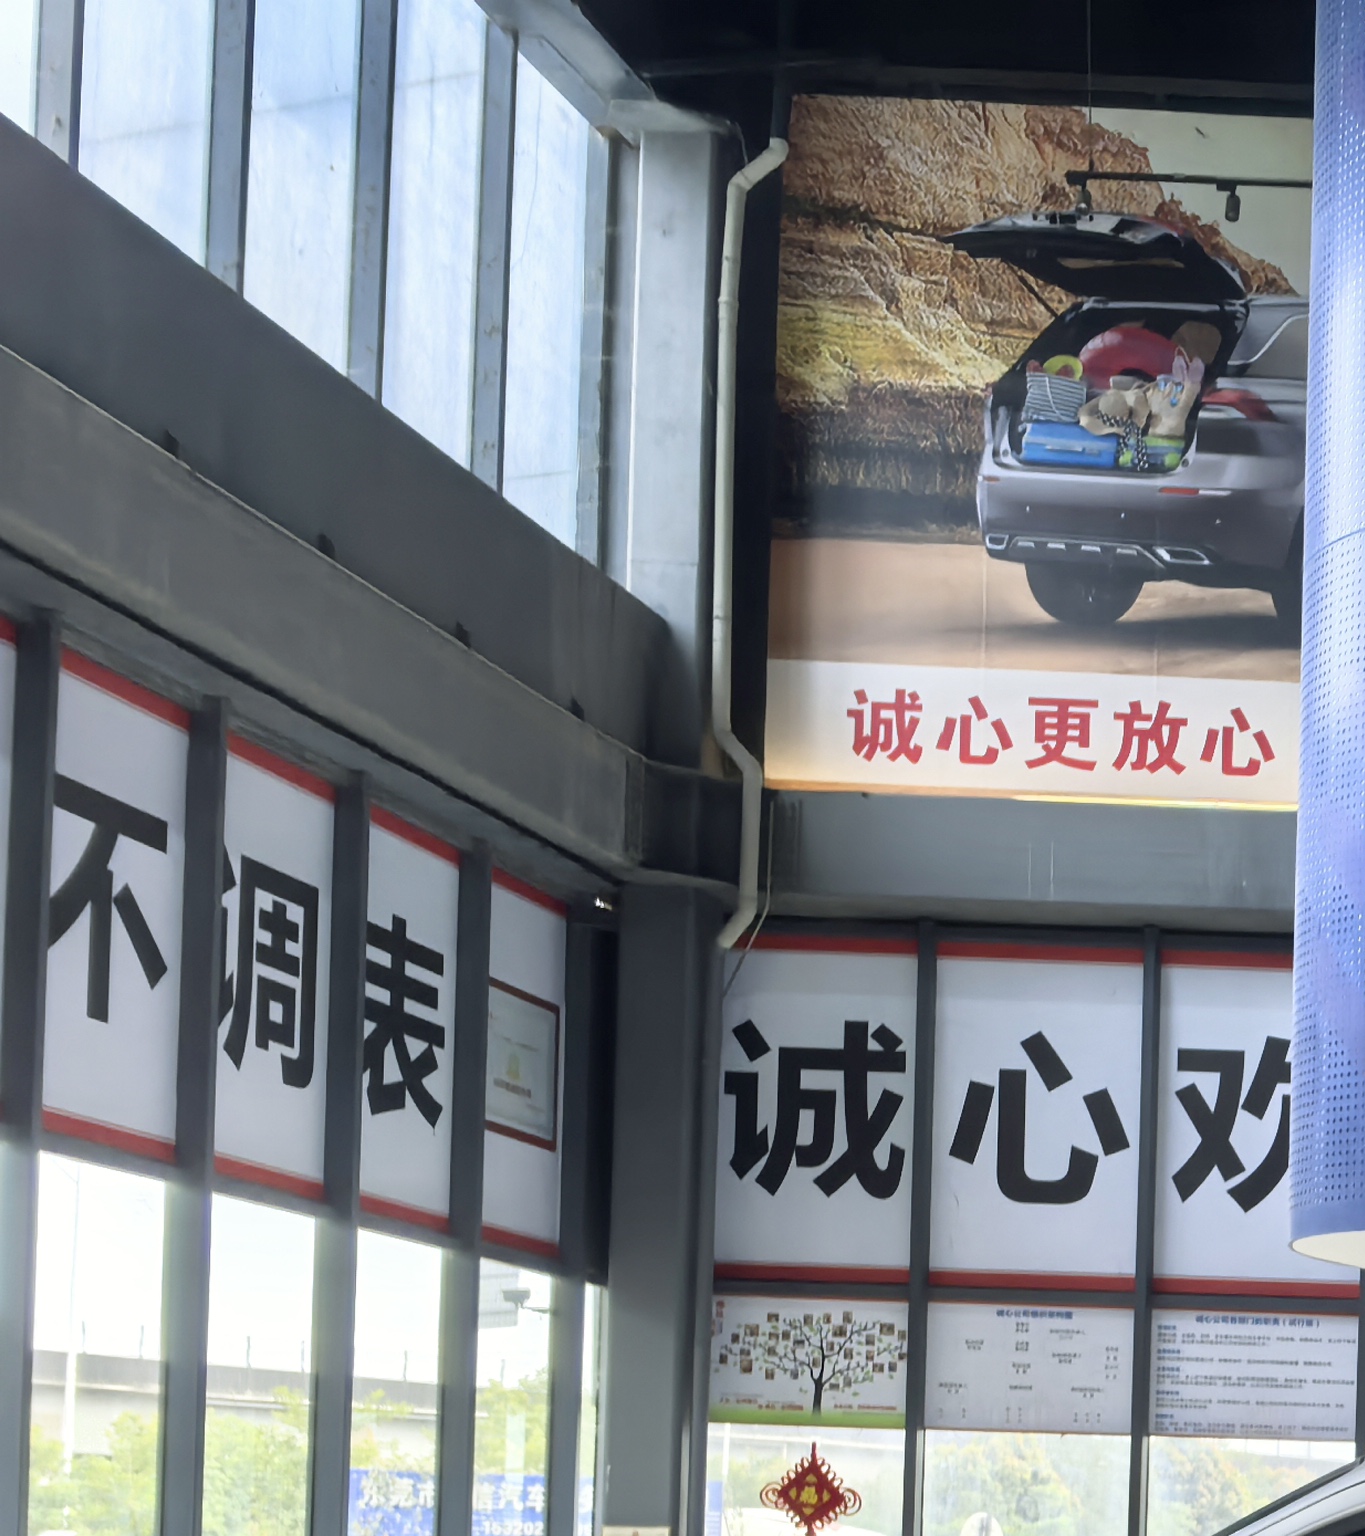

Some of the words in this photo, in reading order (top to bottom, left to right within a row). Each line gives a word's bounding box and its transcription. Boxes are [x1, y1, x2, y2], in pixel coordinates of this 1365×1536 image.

[847, 687, 1276, 778] 诚心更放心
[47, 771, 445, 1130] 不调表
